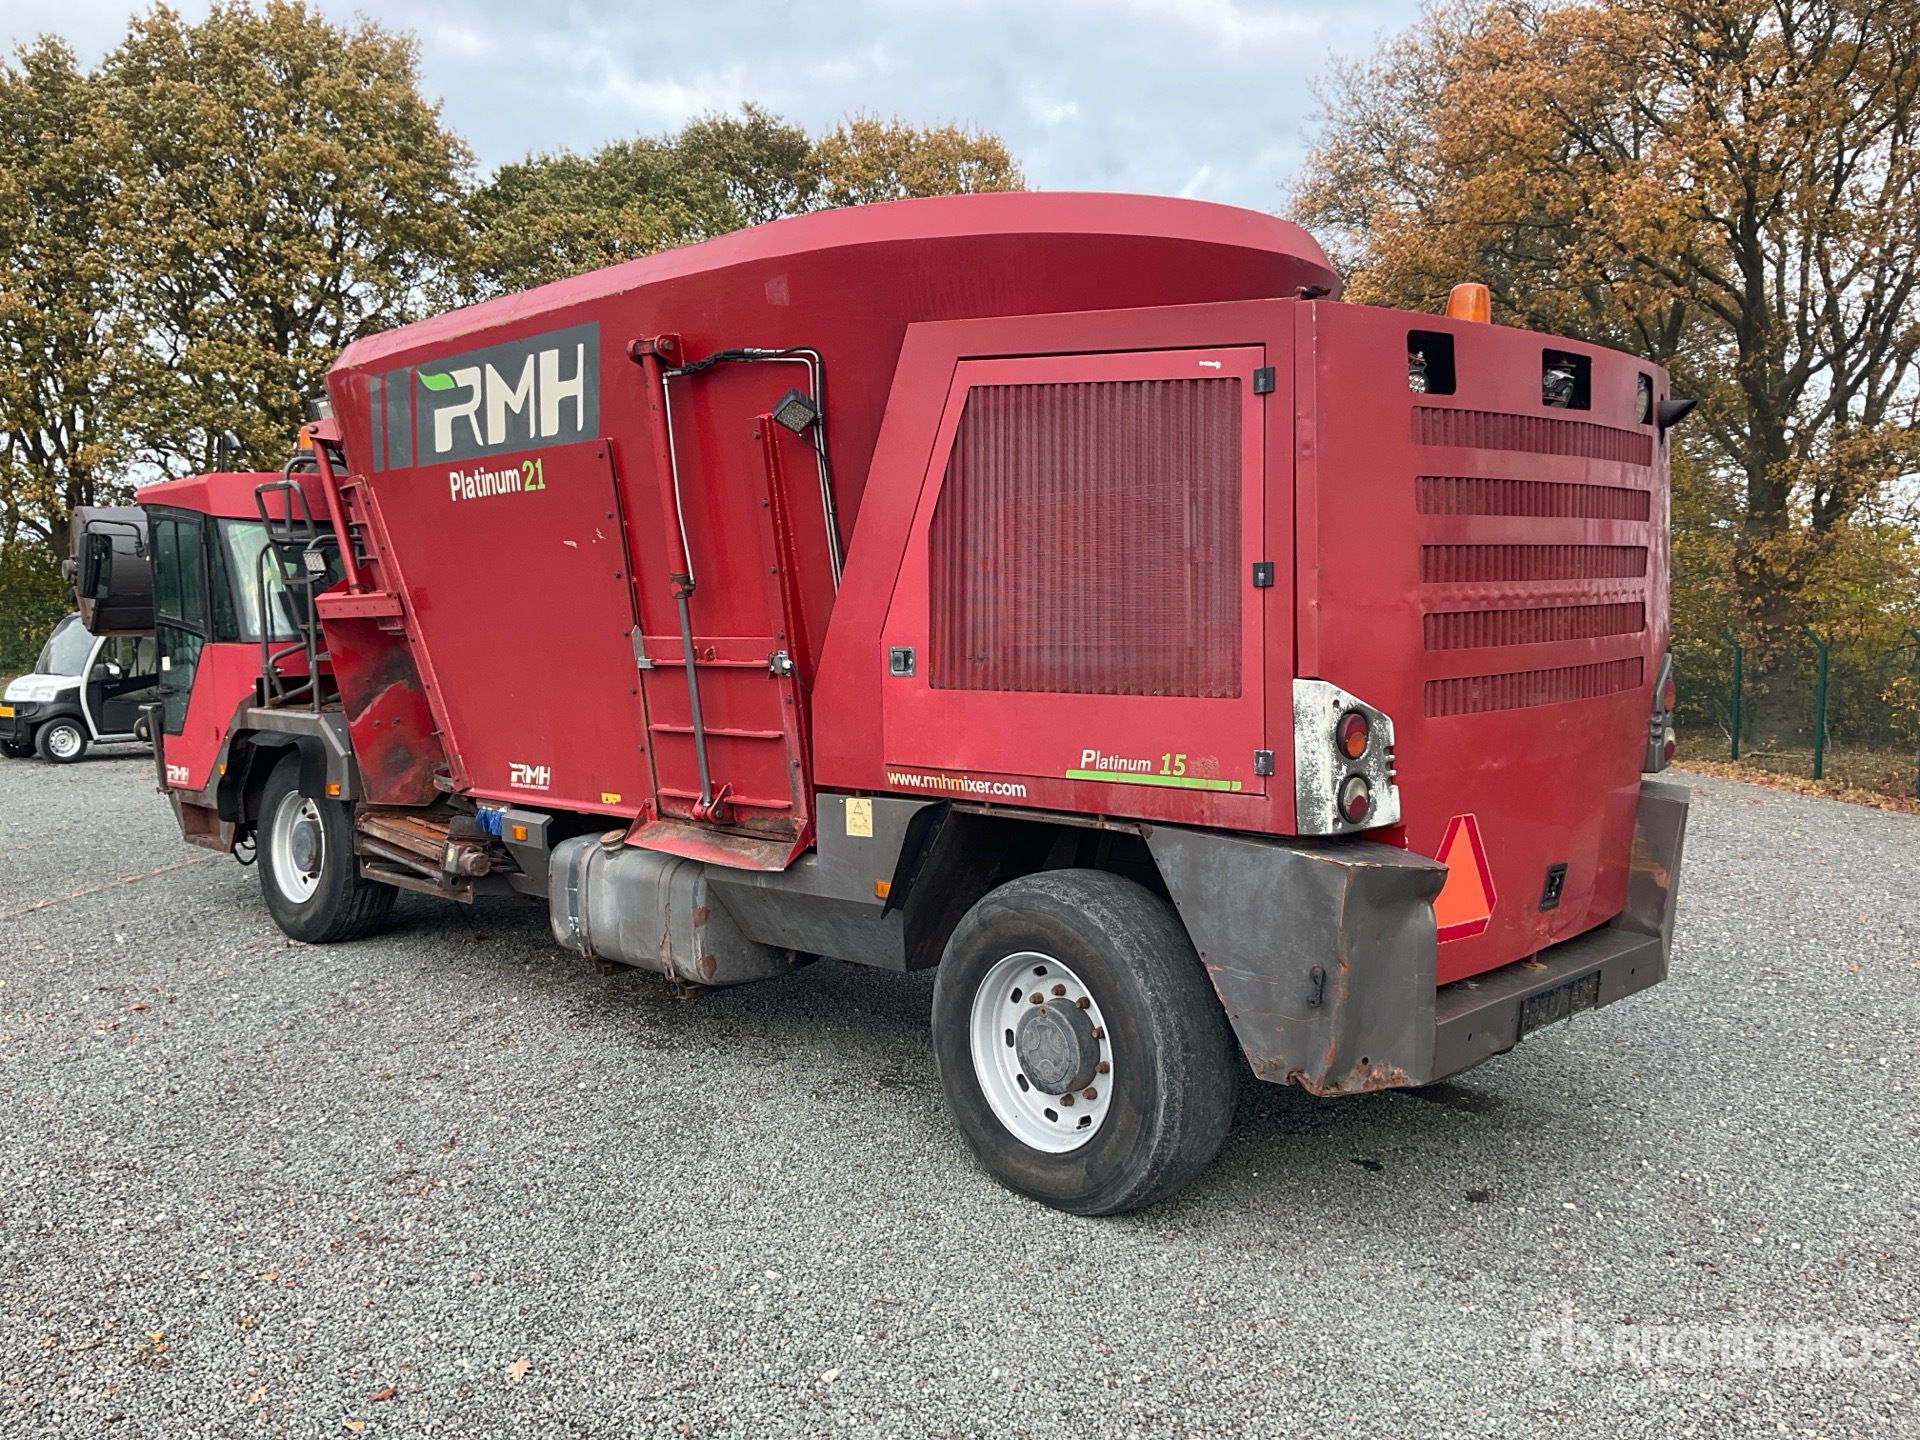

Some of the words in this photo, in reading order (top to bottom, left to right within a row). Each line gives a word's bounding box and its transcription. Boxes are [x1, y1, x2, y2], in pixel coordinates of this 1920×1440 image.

[418, 343, 585, 453] RMH
[450, 467, 521, 501] Platinum
[523, 458, 546, 491] 21
[166, 764, 190, 781] RMH
[509, 761, 550, 785] RMH
[1080, 749, 1151, 772] Platinum
[1160, 753, 1187, 775] 15
[887, 771, 1027, 798] www.rmhmixer.com
